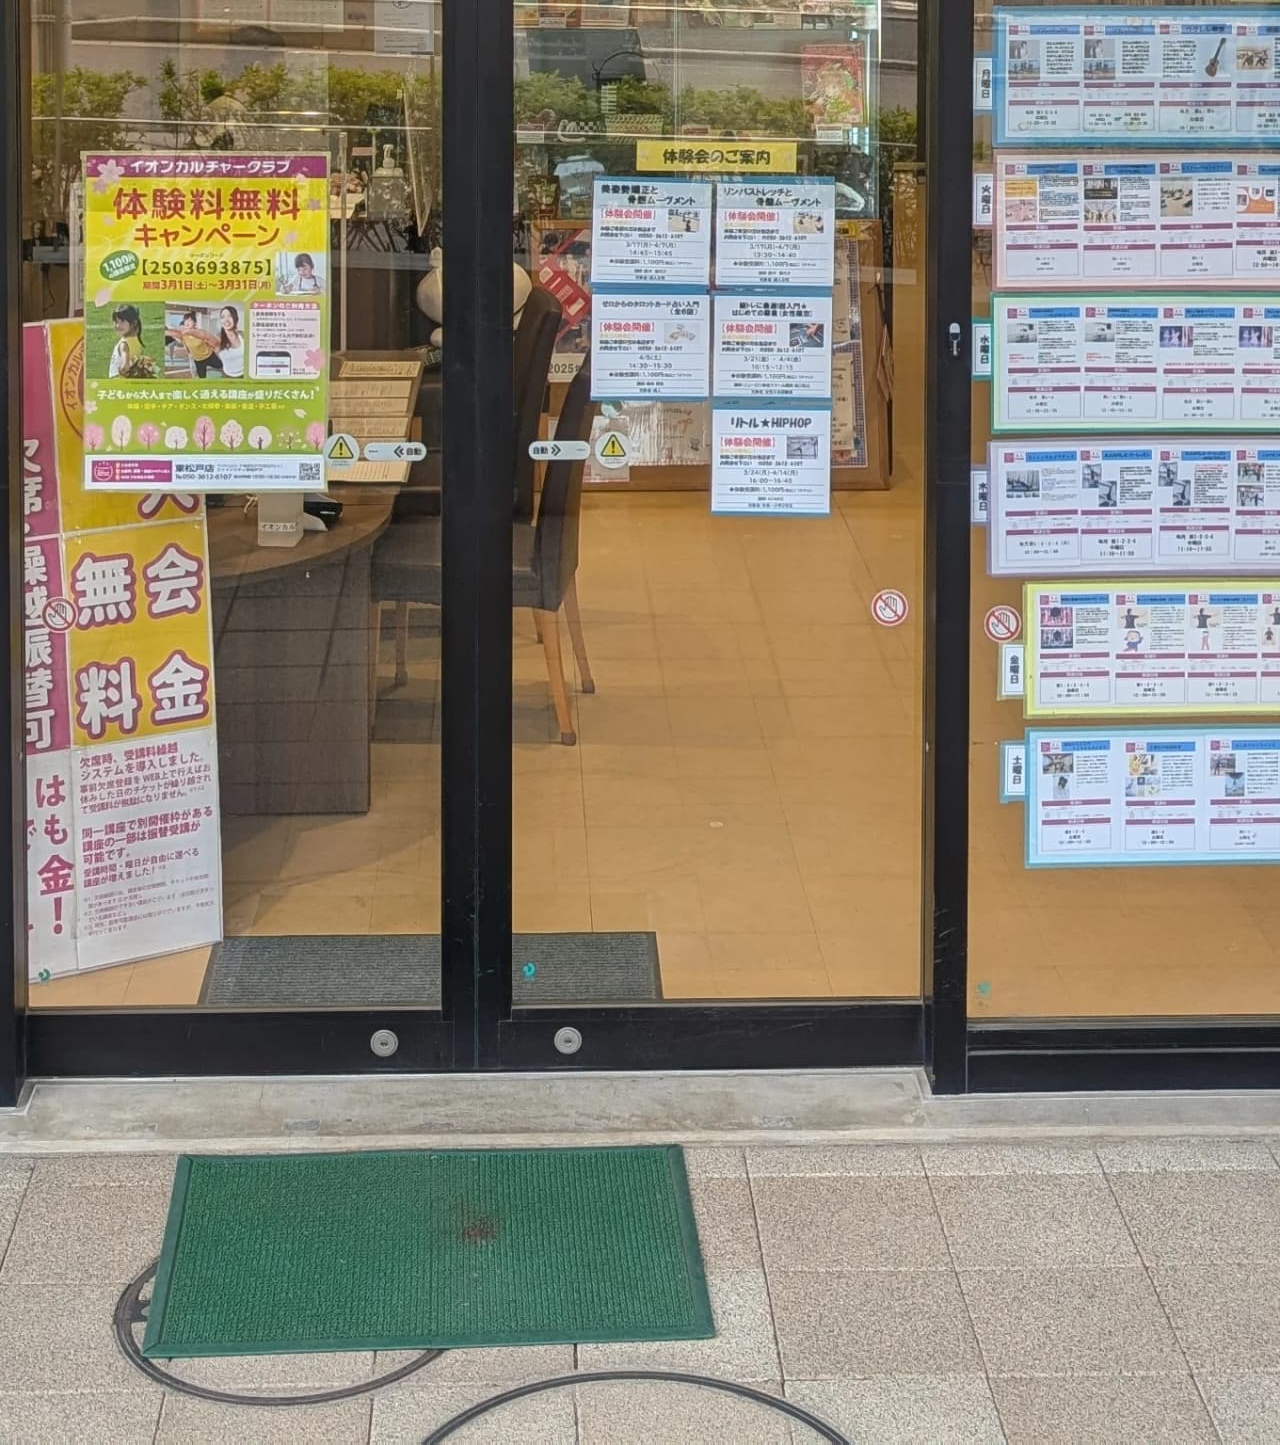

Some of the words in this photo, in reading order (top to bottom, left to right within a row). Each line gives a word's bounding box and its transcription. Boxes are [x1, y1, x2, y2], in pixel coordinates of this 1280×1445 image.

[663, 148, 771, 165] 体験会のご案内
[130, 159, 291, 175] イオンカルチャークラブ
[113, 186, 302, 222] 体験料無料
[133, 223, 280, 249] キャンペーン
[141, 258, 272, 276] 【2503693875】
[407, 445, 422, 455] 自動
[532, 445, 548, 455] 自動
[175, 463, 215, 473] 東松戸店
